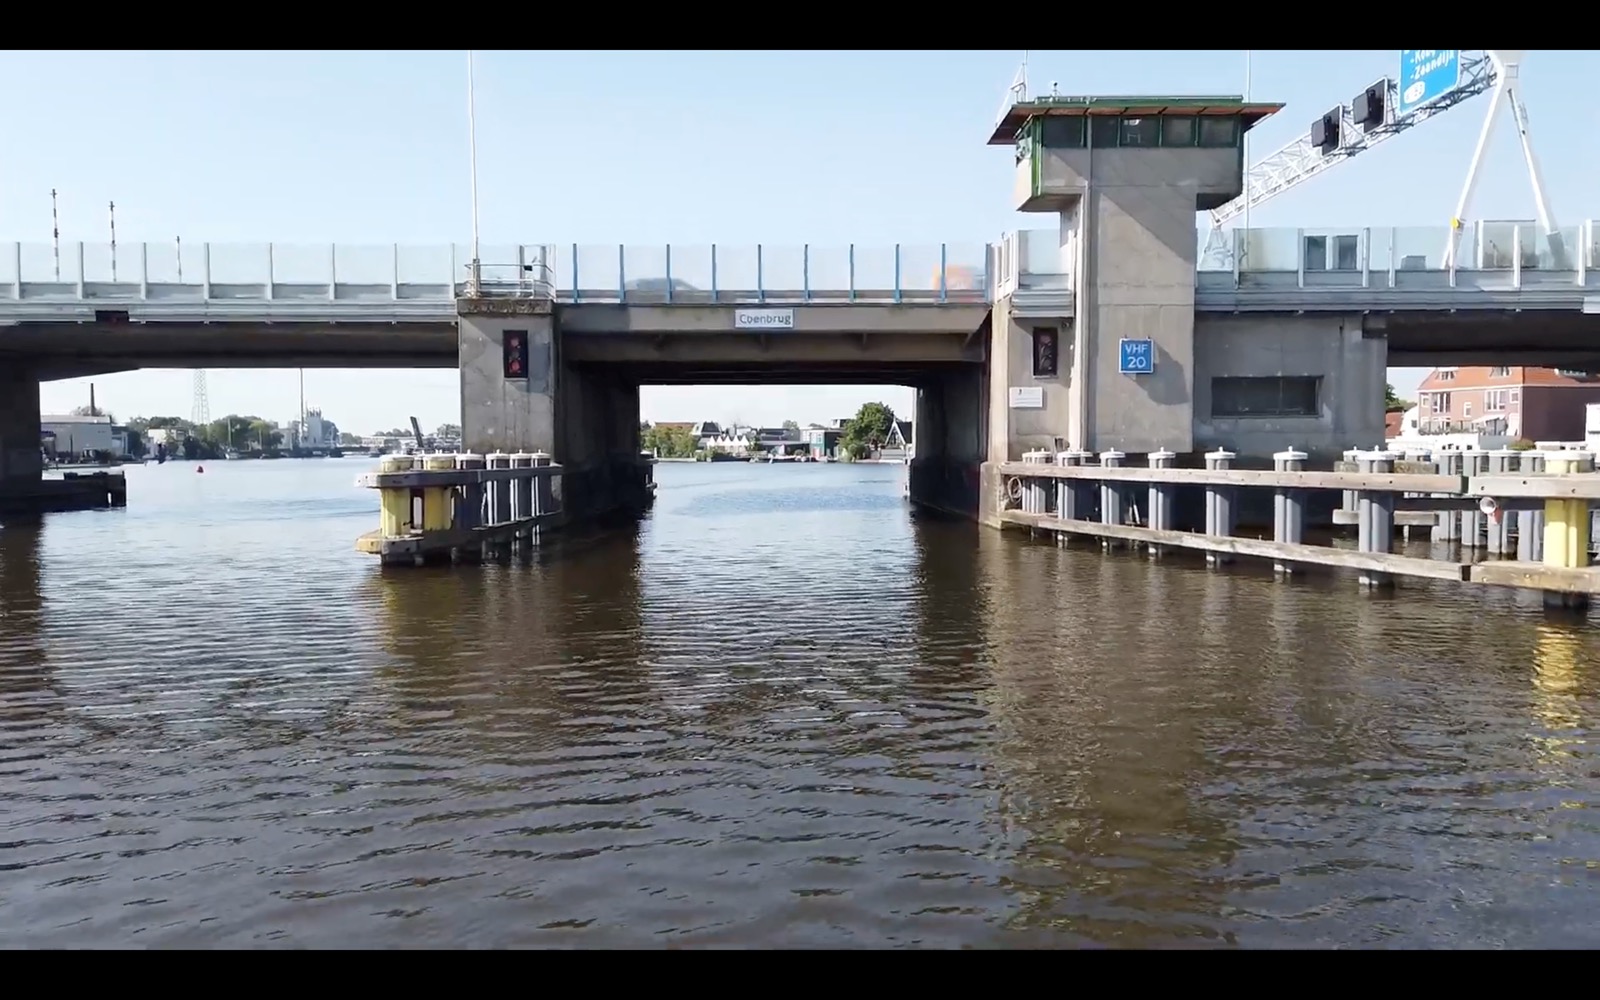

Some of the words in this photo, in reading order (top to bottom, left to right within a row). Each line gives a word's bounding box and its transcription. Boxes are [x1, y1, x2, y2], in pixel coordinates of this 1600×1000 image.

[739, 313, 792, 326] Coenbrug
[1125, 343, 1148, 354] VHF
[1127, 356, 1147, 368] 20
